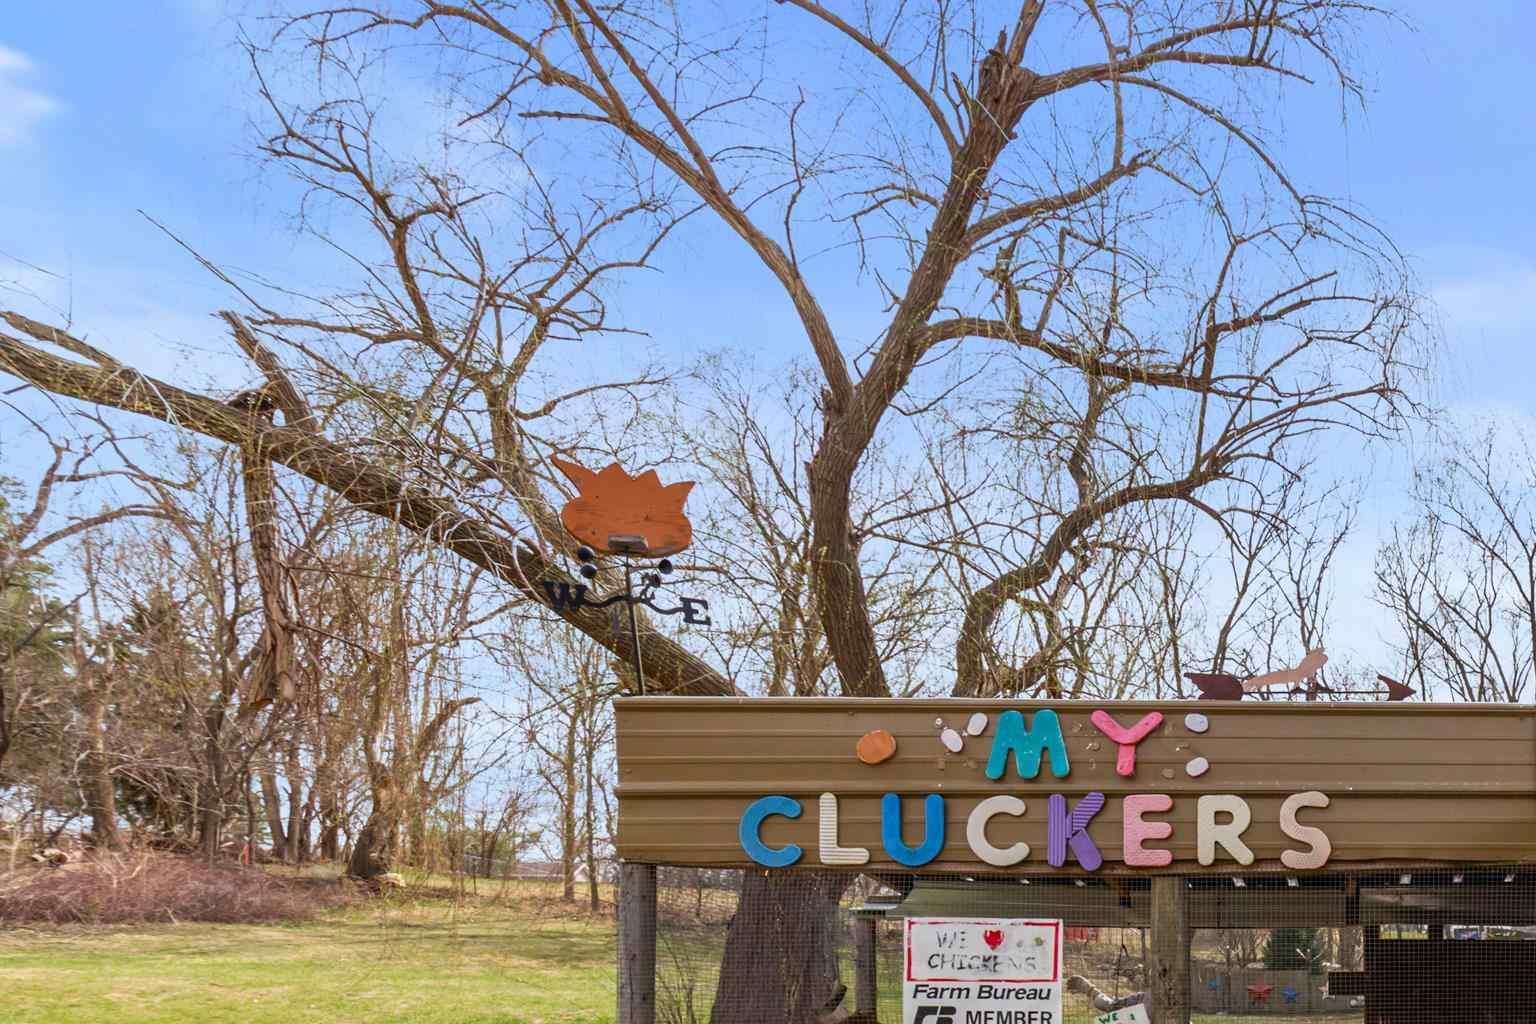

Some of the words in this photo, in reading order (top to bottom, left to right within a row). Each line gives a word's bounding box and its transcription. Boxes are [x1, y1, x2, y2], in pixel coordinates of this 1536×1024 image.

[985, 708, 1164, 780] MY
[738, 790, 1332, 872] CLUCKERS
[912, 984, 970, 1000] Farm
[977, 985, 1051, 1001] Bureau
[1098, 1012, 1119, 1024] WE
